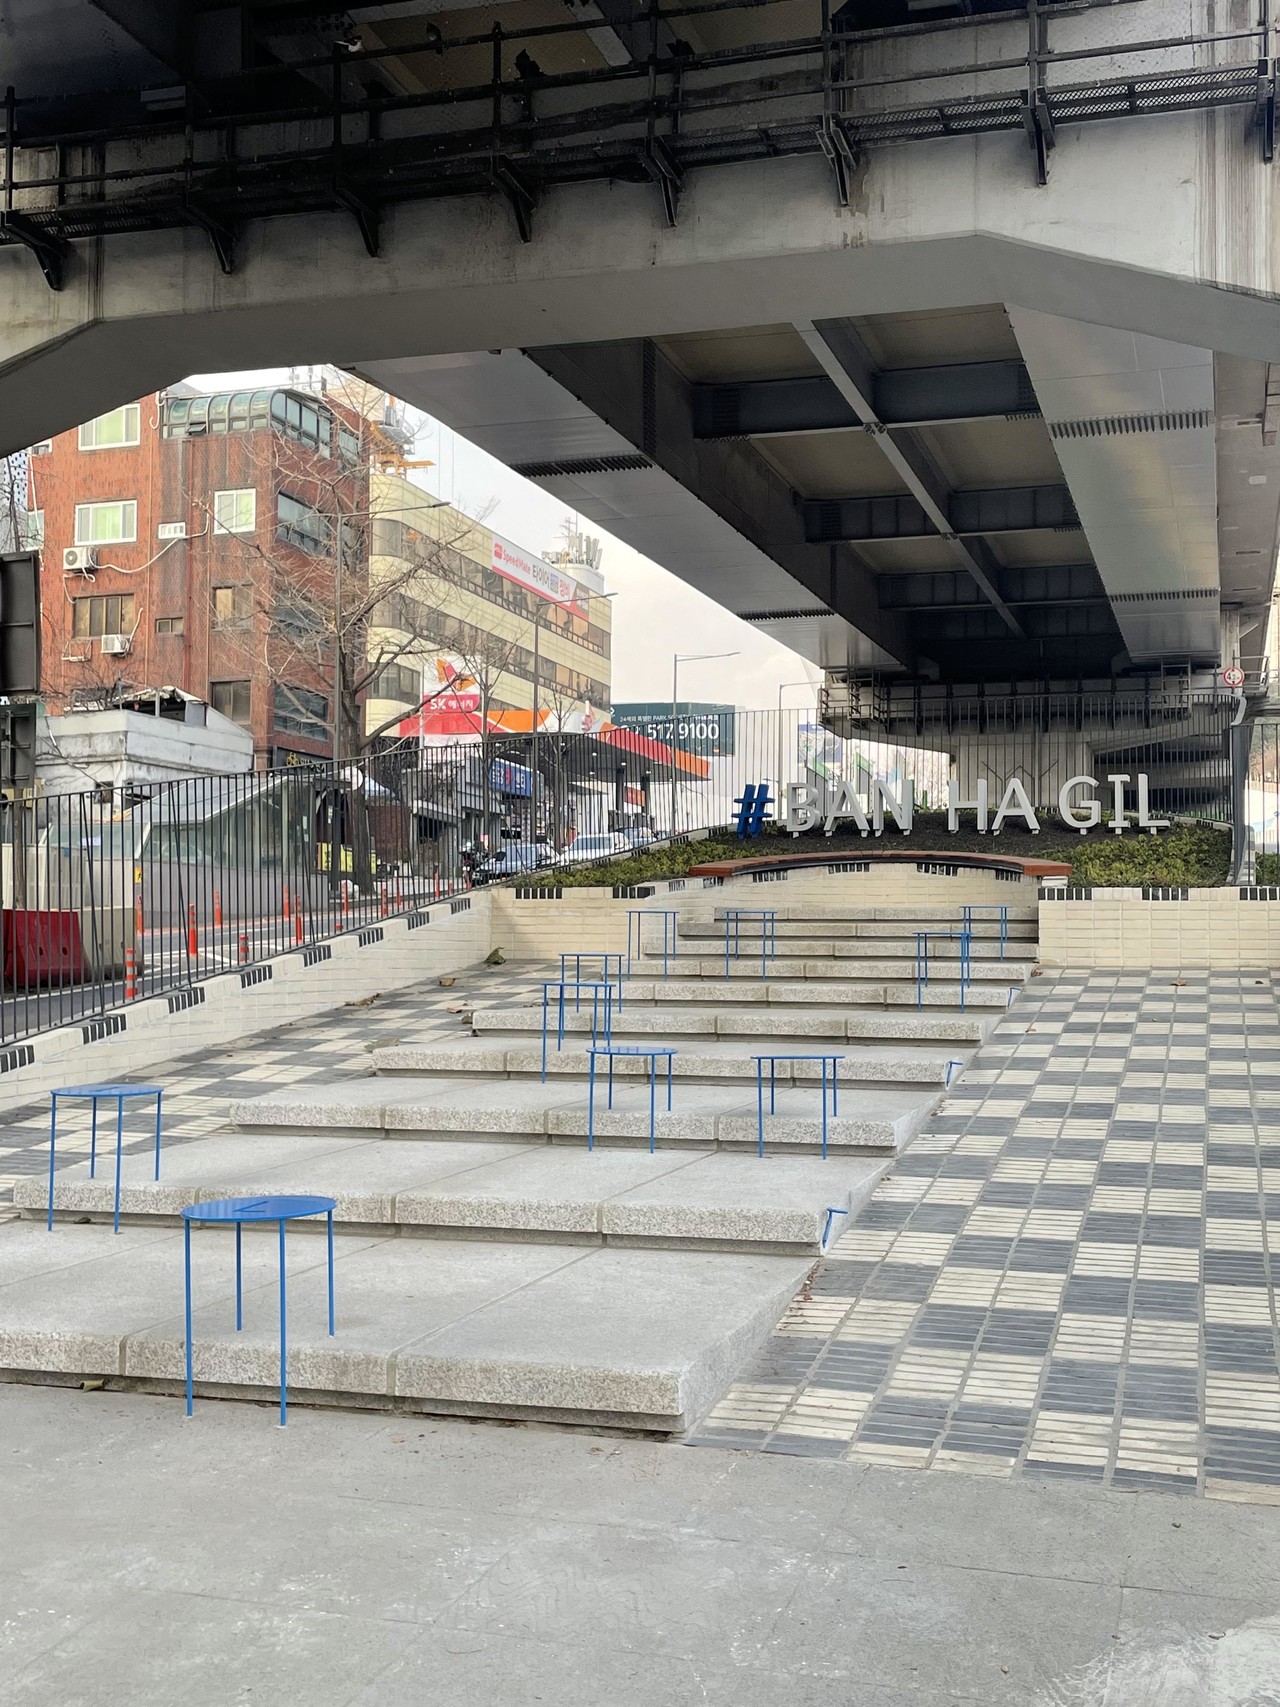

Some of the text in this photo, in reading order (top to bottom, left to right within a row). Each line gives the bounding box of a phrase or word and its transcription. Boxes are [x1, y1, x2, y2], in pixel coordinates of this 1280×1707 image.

[532, 564, 550, 589] 타이어
[430, 699, 447, 710] SK
[678, 722, 720, 740] 9100
[948, 777, 1041, 833] HA
[1059, 773, 1170, 830] GIL
